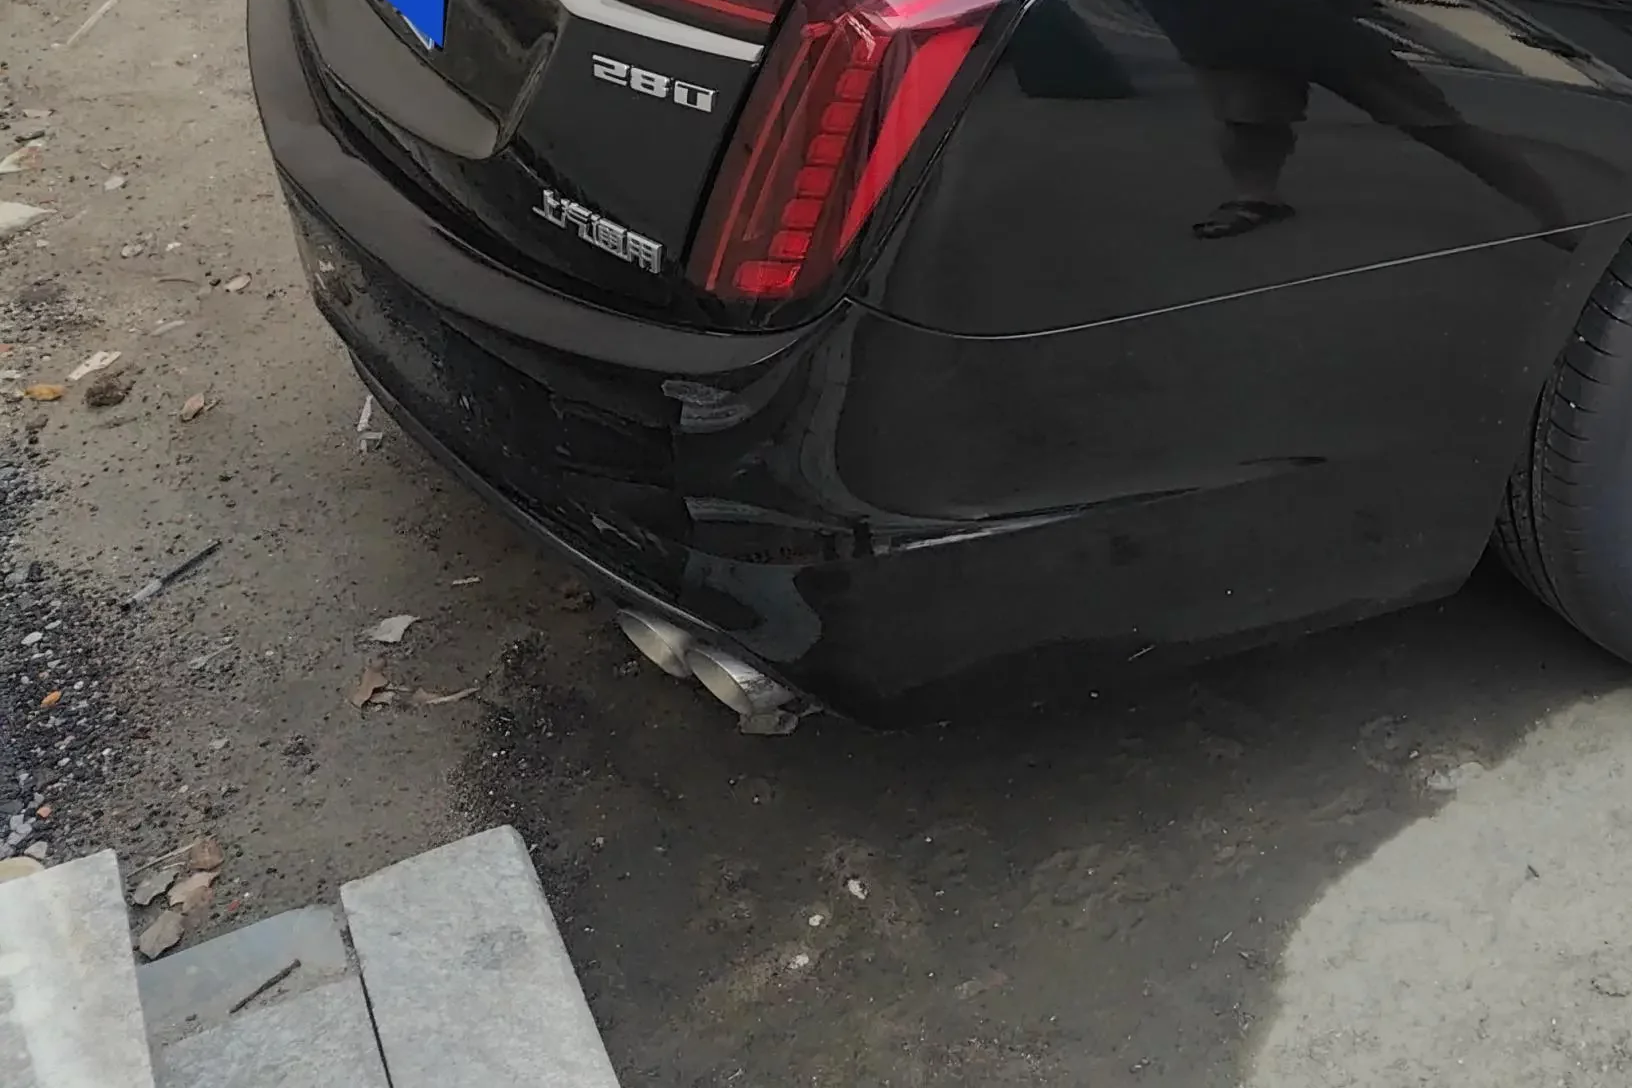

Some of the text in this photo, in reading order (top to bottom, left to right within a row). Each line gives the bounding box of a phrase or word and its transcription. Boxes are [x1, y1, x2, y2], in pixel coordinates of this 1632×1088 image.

[592, 54, 716, 112] 28T
[532, 190, 663, 273] 上汽通用
